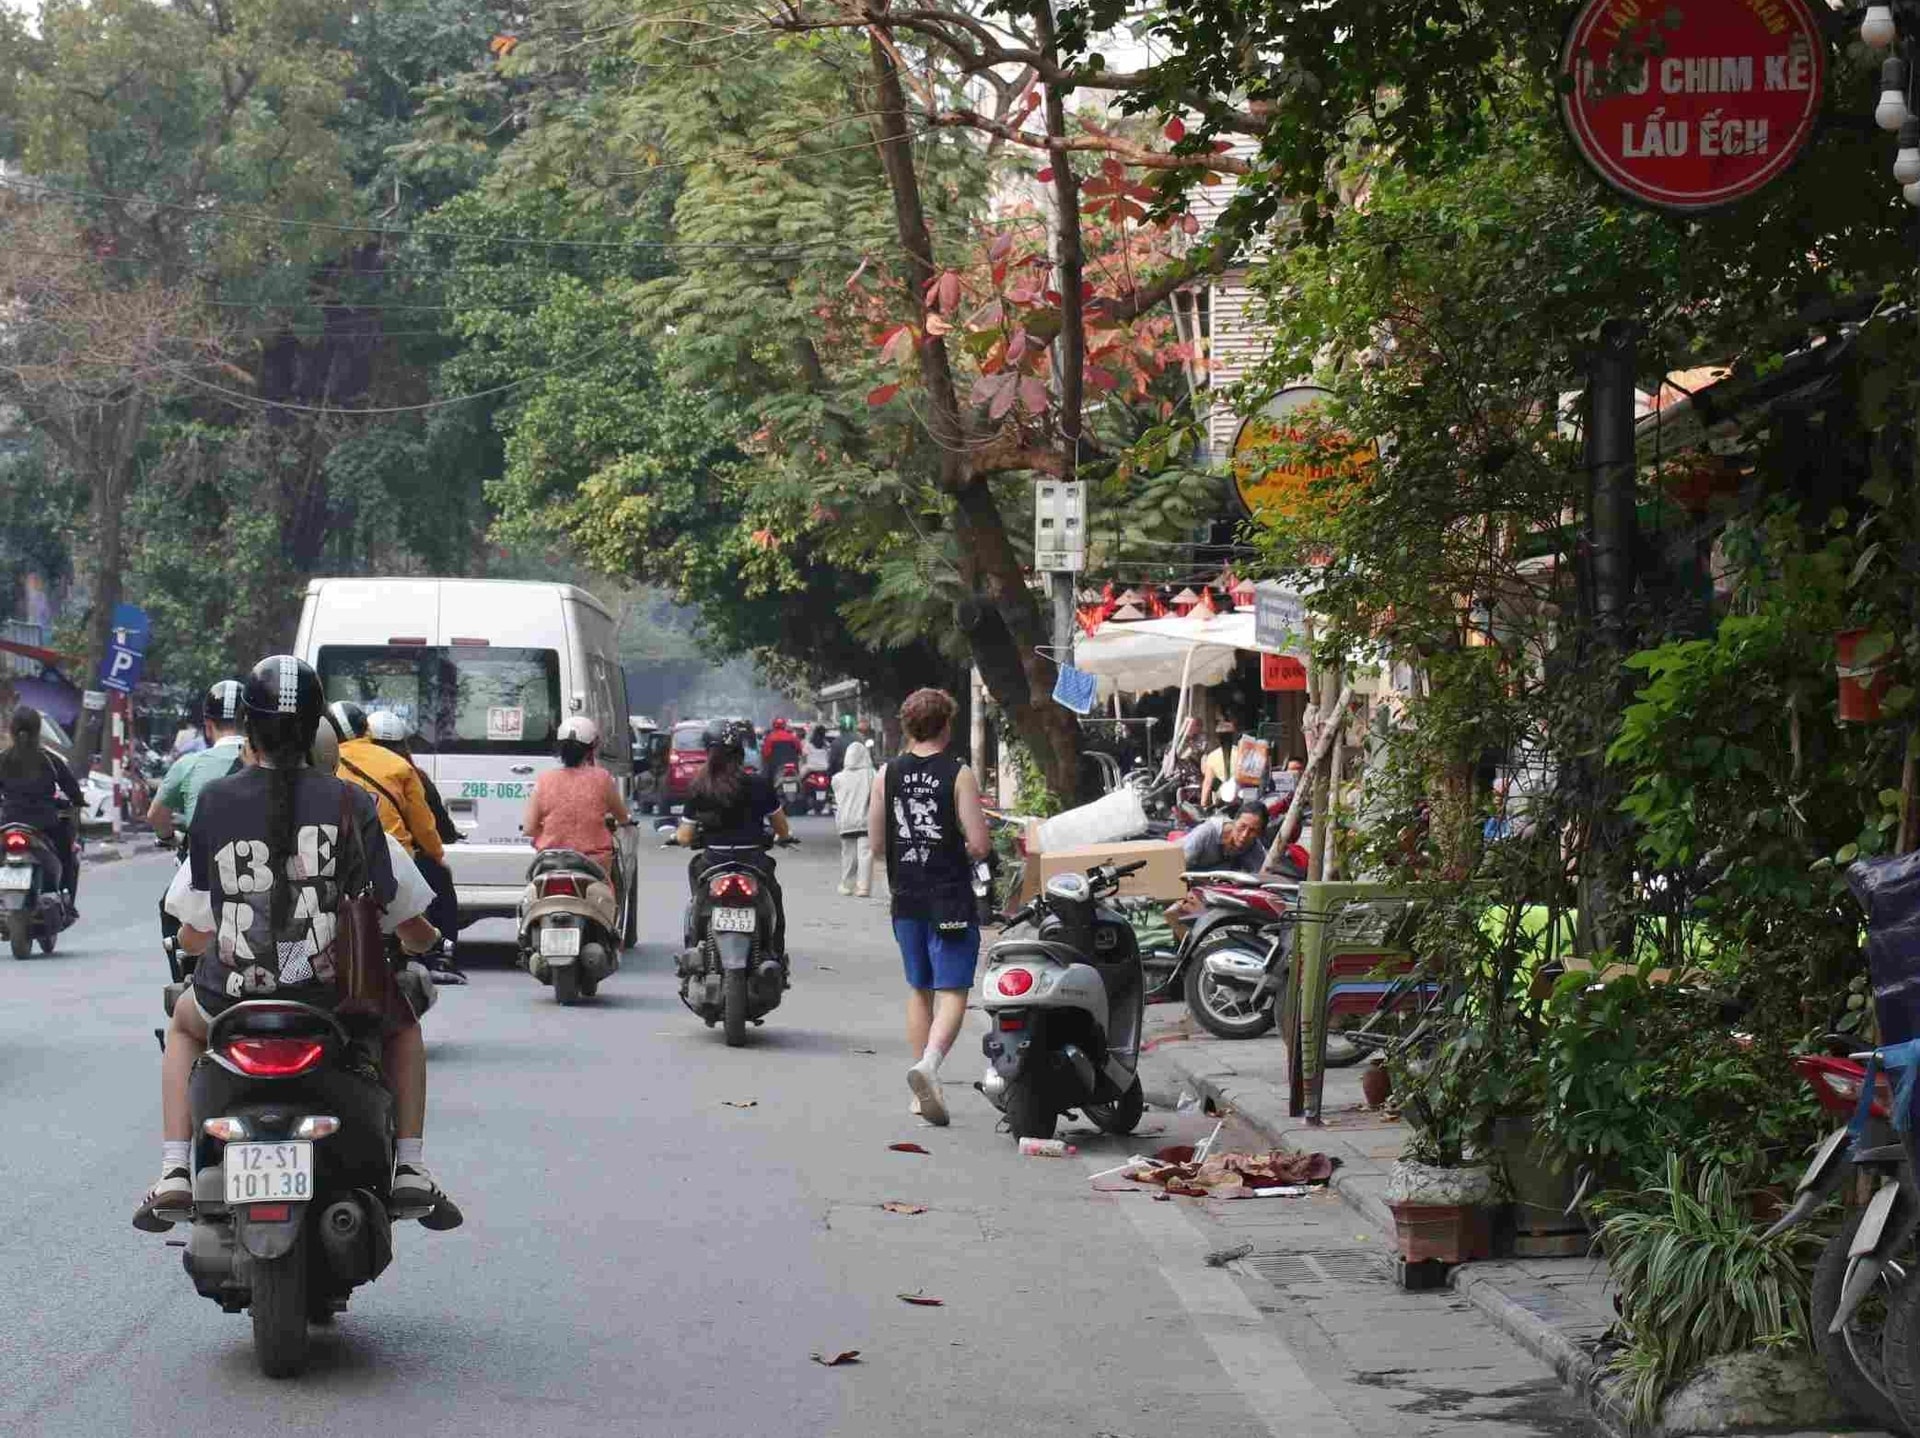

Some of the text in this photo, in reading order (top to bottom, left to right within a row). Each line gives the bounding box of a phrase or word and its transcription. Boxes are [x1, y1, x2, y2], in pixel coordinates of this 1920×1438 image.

[1660, 56, 1753, 93] CHIM
[110, 651, 133, 677] P
[240, 1145, 298, 1170] 12-S1
[232, 1171, 307, 1199] 101.38
